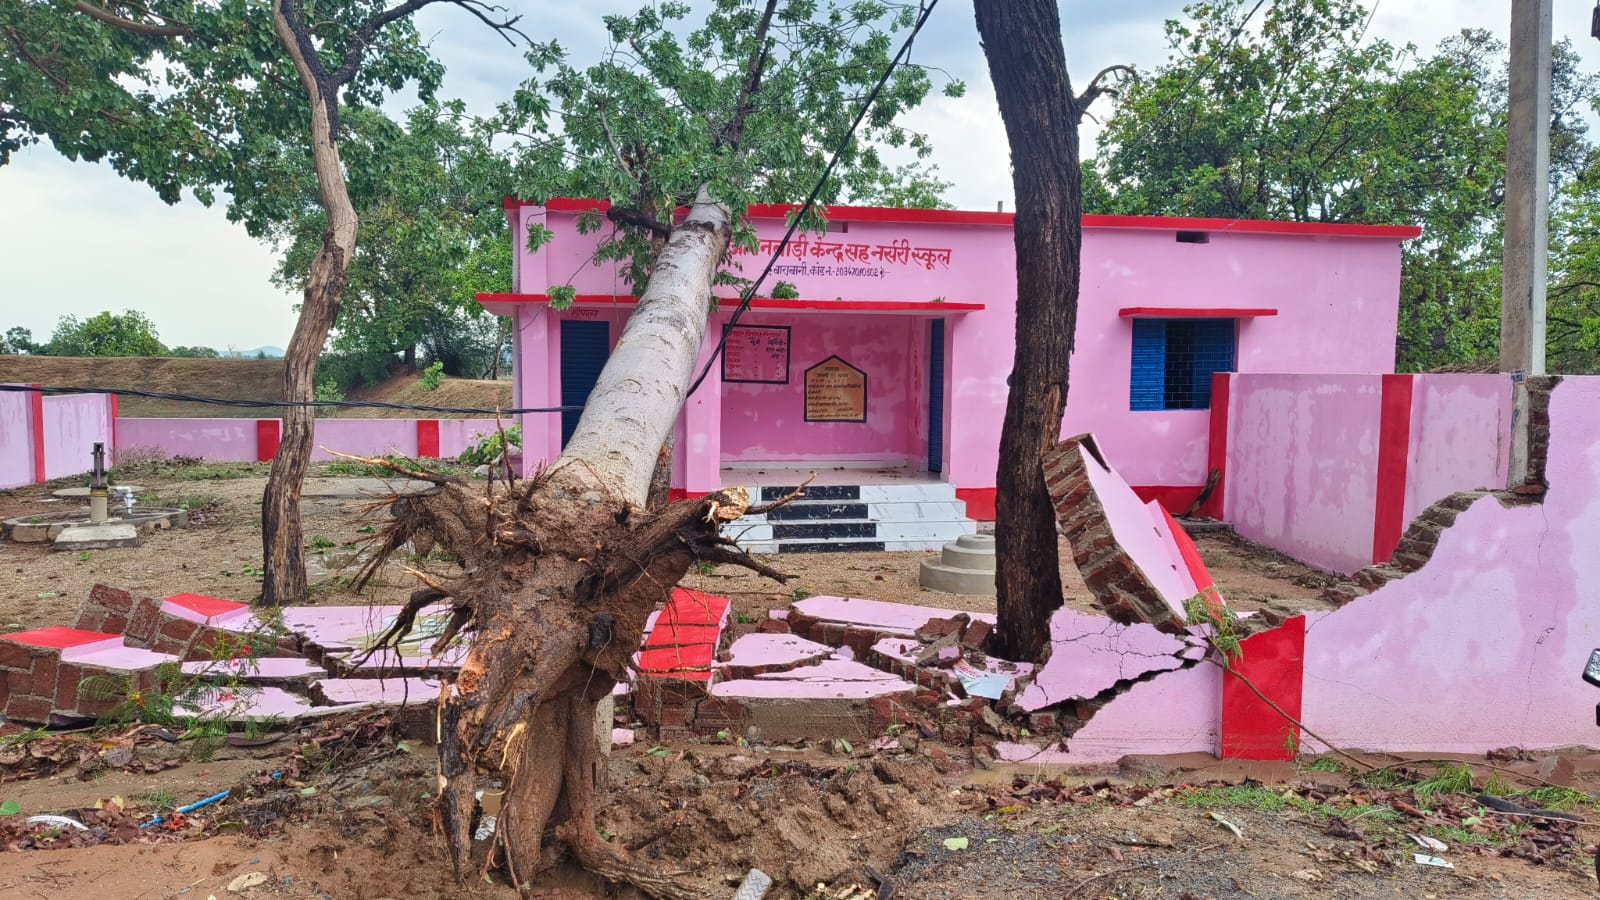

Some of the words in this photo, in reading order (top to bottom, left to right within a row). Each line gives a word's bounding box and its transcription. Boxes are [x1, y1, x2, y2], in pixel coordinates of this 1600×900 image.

[845, 243, 870, 264] सह
[871, 239, 910, 265] नर्सरी
[911, 247, 952, 270] स्कूल
